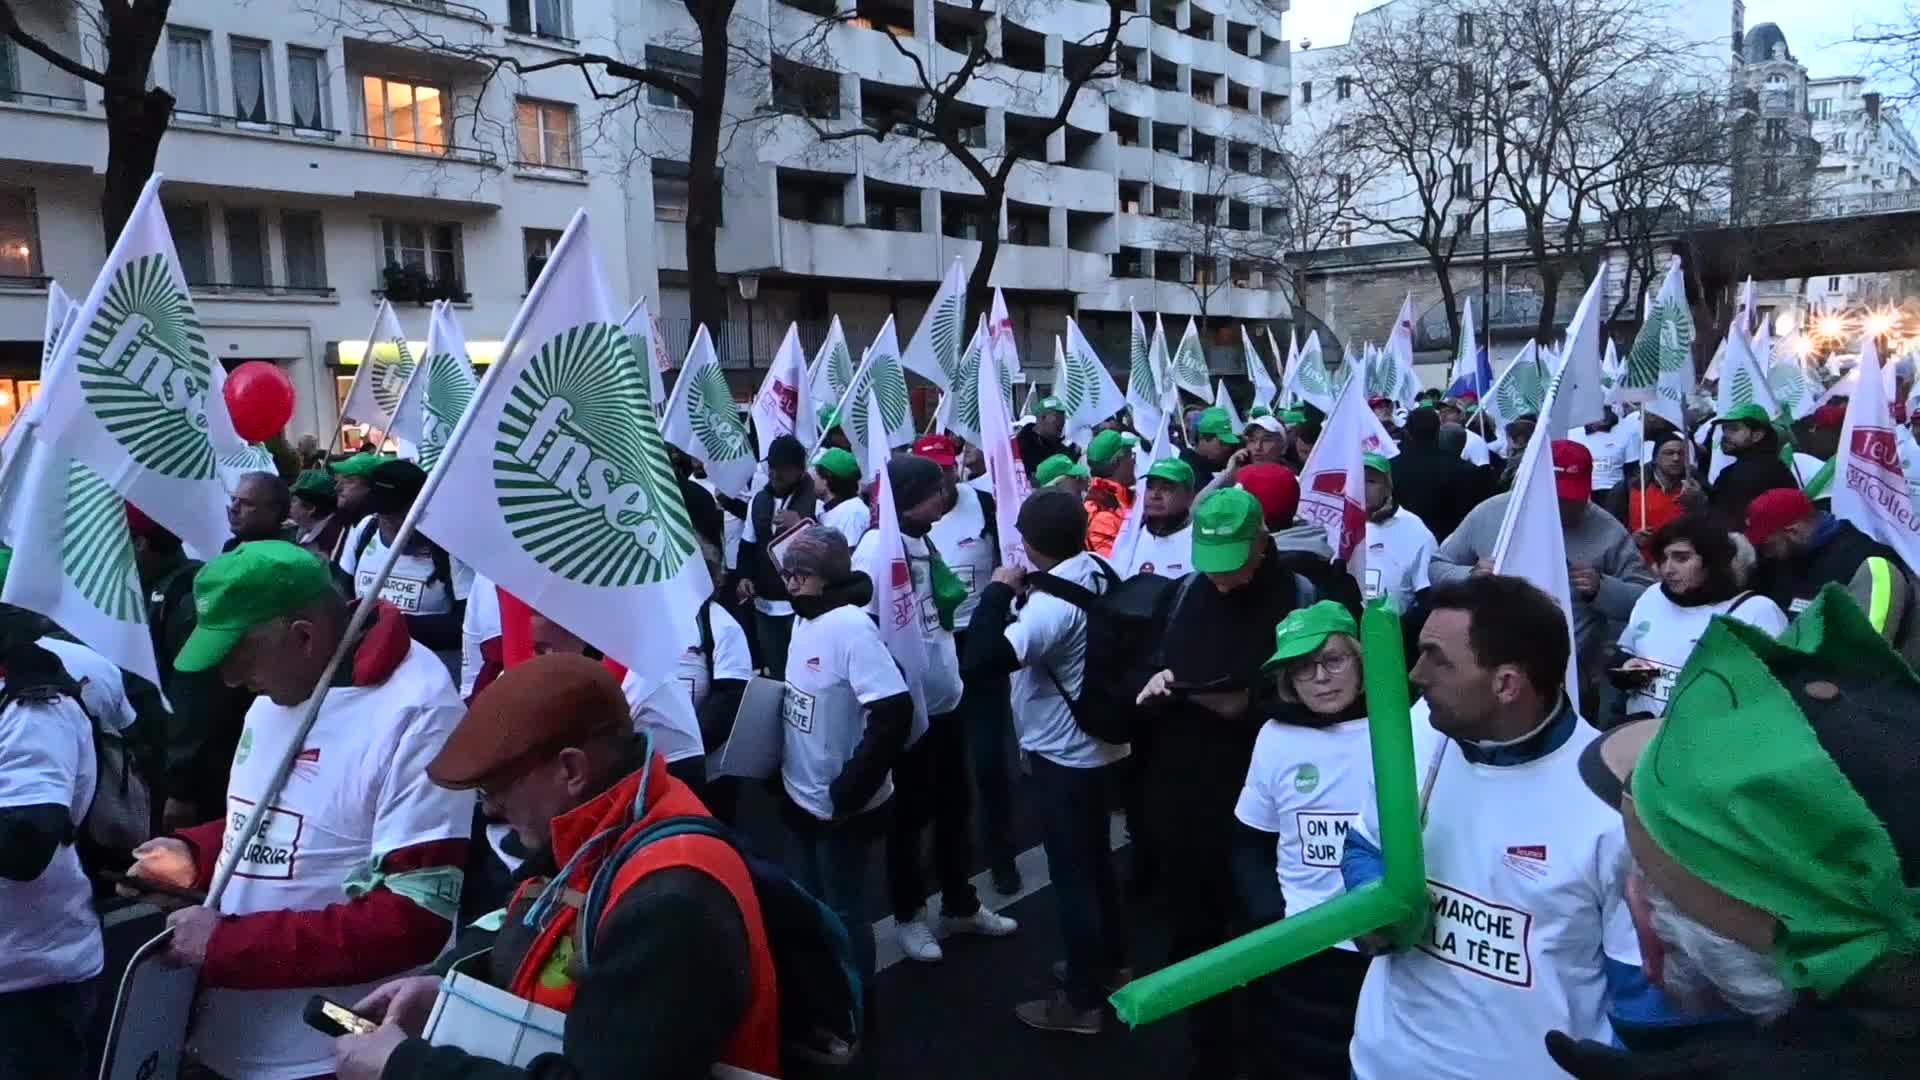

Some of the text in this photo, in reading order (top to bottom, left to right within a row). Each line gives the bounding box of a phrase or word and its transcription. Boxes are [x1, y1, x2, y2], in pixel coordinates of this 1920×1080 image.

[1857, 432, 1897, 465] Jeu
[513, 395, 664, 561] fnsea
[1847, 469, 1920, 532] griculteu
[384, 578, 416, 594] ARCHE
[1307, 820, 1328, 837] ON
[243, 843, 288, 865] URRIR
[1306, 843, 1336, 861] SUR
[1433, 895, 1516, 940] MARCHE
[1431, 924, 1521, 976] LA TÊTE
